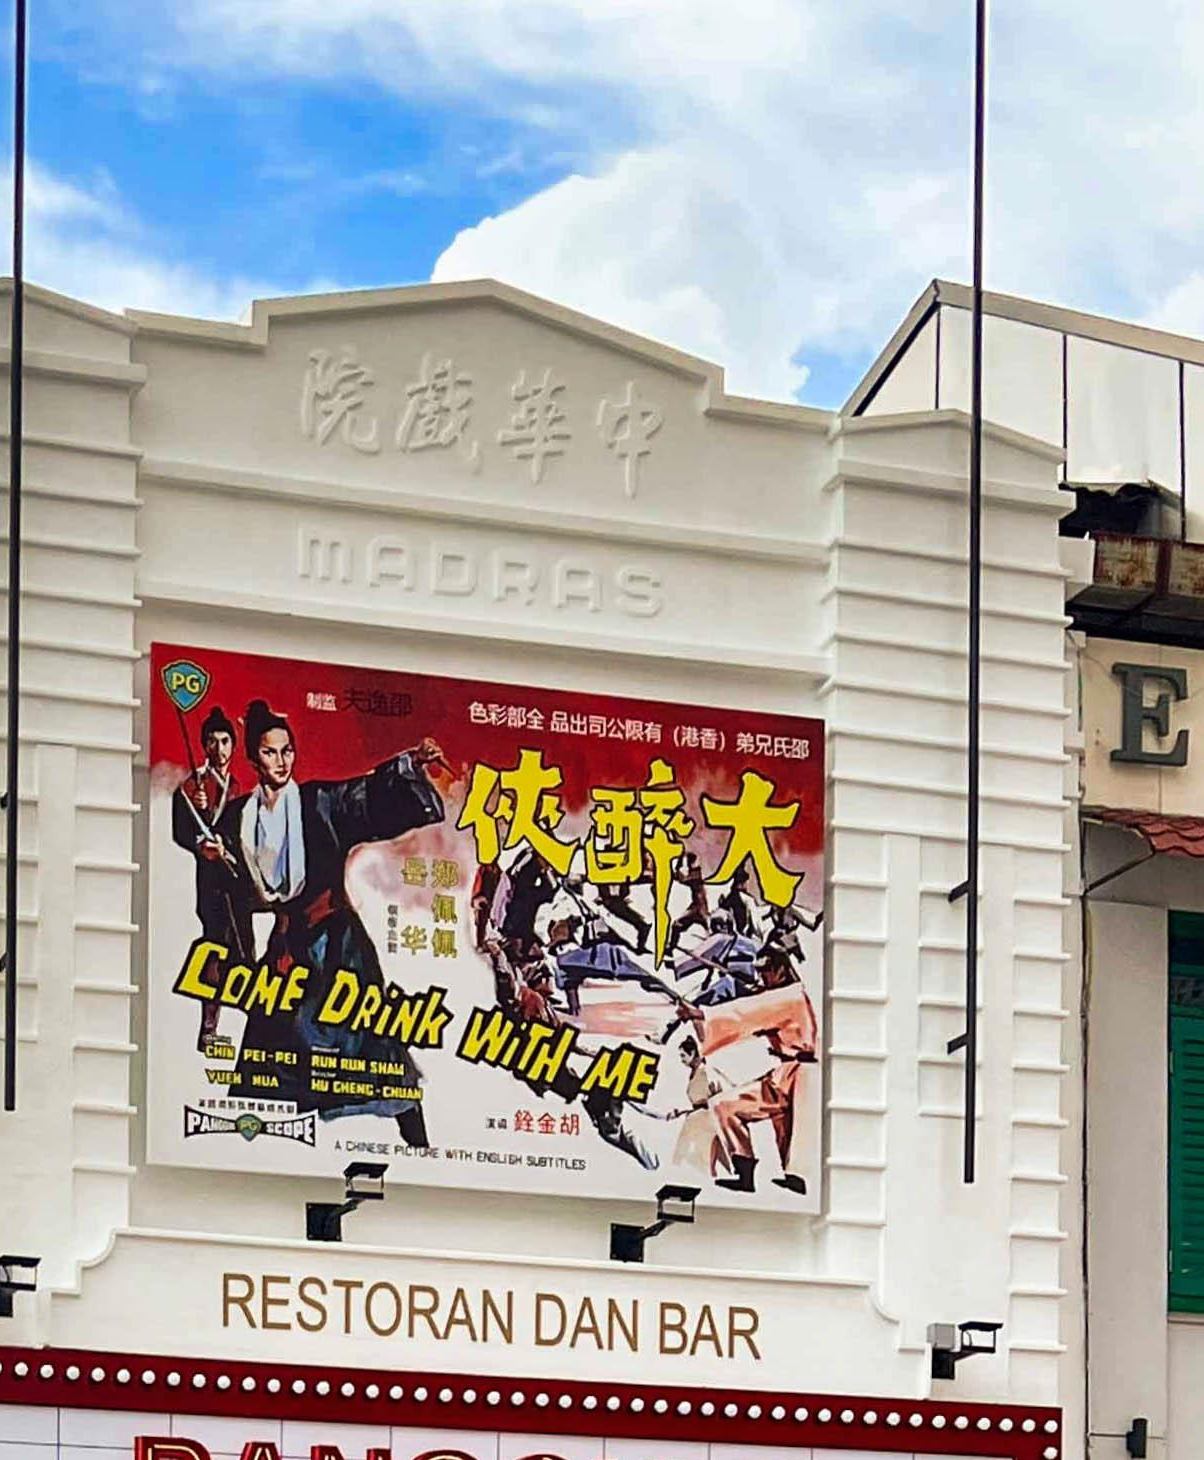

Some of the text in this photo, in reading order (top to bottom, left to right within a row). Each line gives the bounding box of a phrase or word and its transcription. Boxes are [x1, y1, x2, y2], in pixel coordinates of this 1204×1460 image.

[298, 527, 663, 618] MADRAS
[172, 671, 200, 693] PG
[178, 942, 310, 1017] COME
[582, 1047, 659, 1100] ME
[311, 1055, 337, 1069] RUN
[340, 1058, 366, 1072] RUN
[265, 1117, 314, 1143] SCOPE
[335, 1140, 586, 1171] A CHINESE PICTURE WITH ENGLISH SUBTITLES
[221, 1273, 762, 1361] RESTORAN DAN BAR
